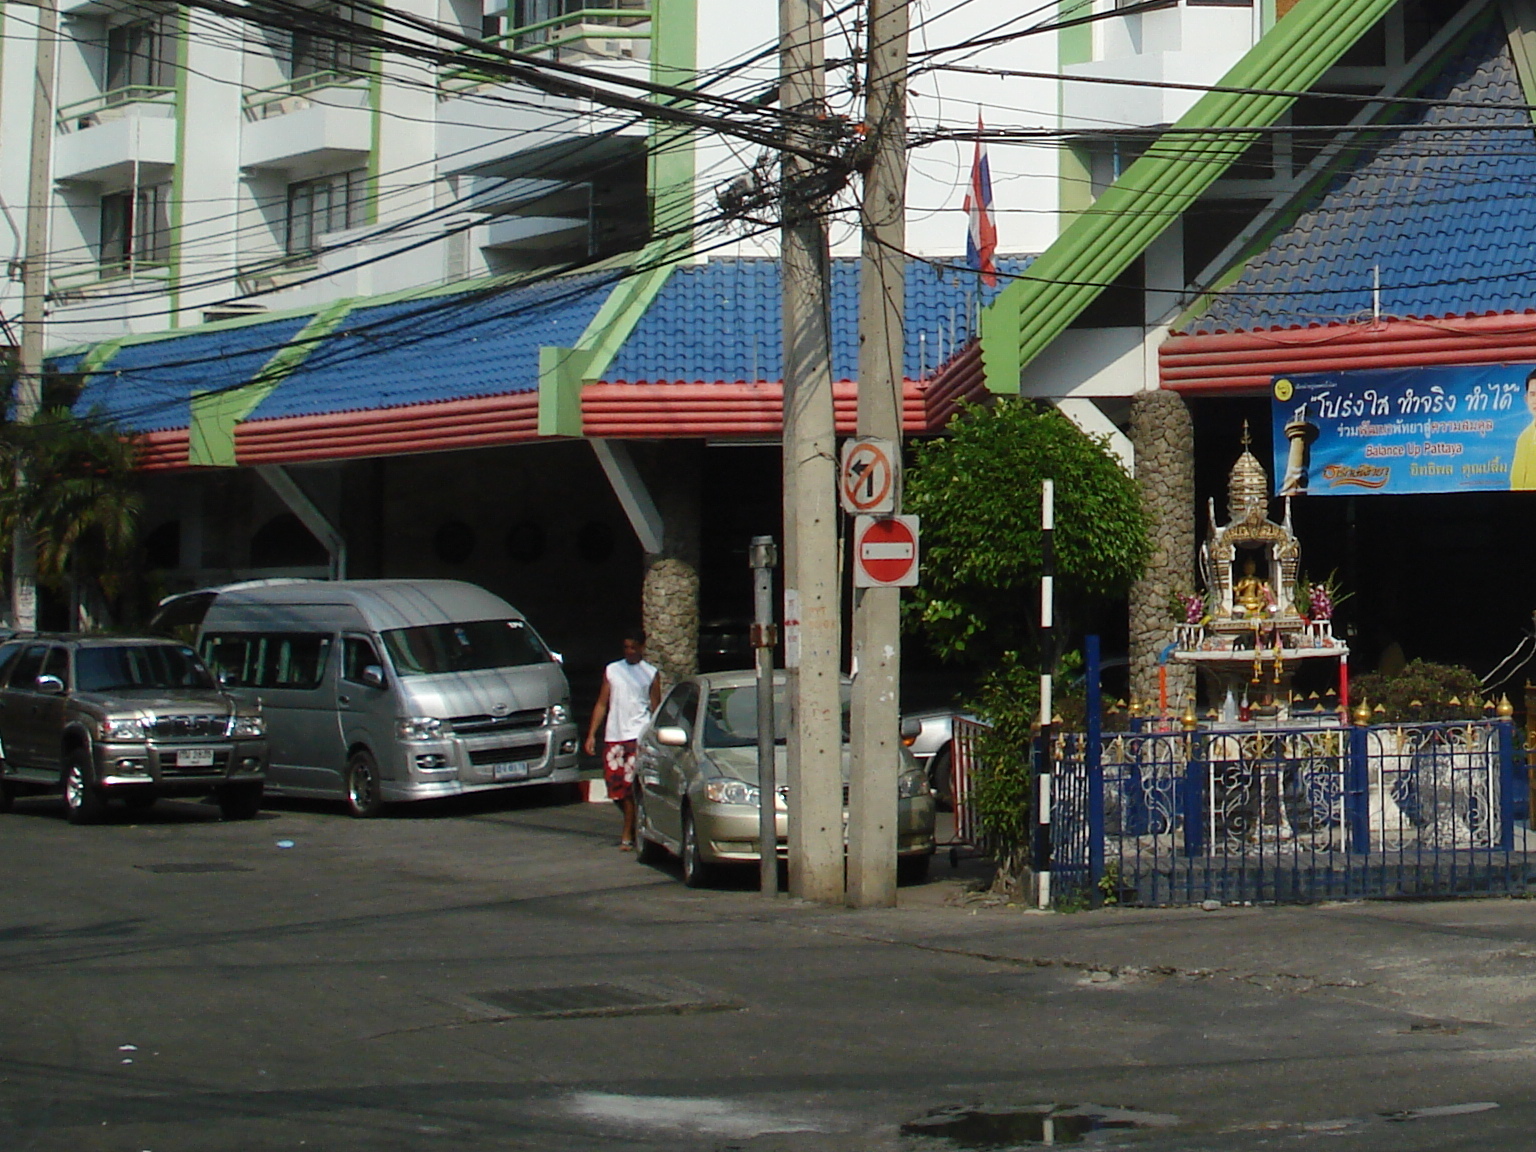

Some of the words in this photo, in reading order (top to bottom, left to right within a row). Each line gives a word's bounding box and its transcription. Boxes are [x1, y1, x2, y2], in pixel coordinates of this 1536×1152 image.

[1398, 385, 1457, 414] ทำจริง
[1365, 444, 1405, 458] Balance
[1406, 444, 1421, 458] Up
[1424, 442, 1463, 457] Pattaya
